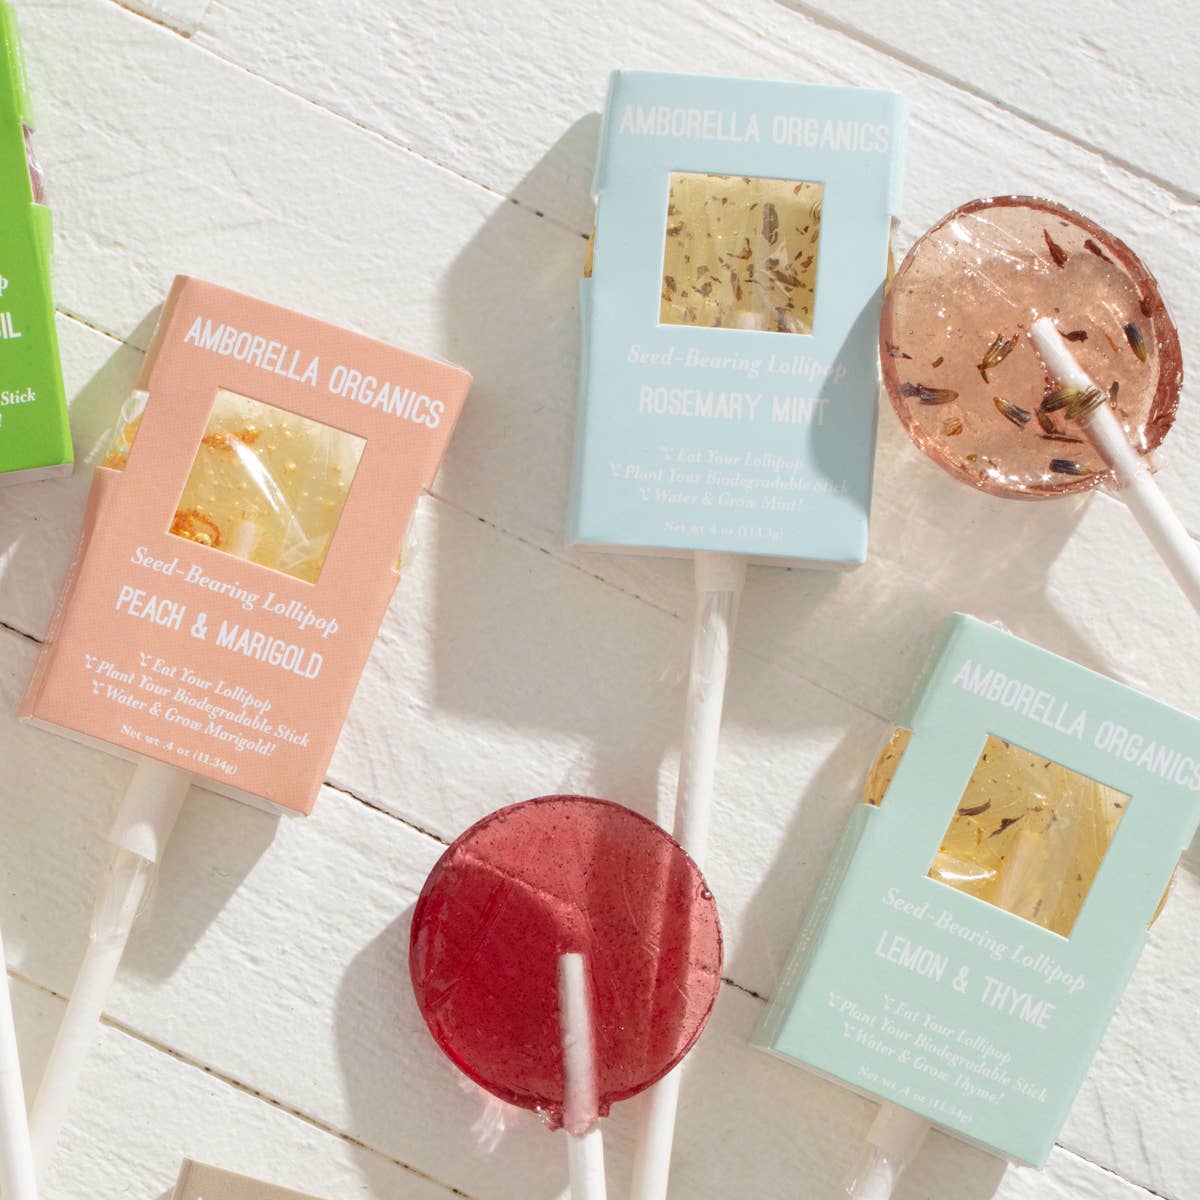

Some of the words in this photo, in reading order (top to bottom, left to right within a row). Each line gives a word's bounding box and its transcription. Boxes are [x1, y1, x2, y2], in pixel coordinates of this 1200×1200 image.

[618, 103, 761, 144] AMBORELLA
[772, 114, 889, 153] ORGANICS
[183, 316, 320, 388] AMBORELLA
[327, 364, 445, 429] ORGANICS
[627, 344, 763, 379] Seed-Bearing
[767, 352, 848, 385] Lollipop
[639, 384, 764, 421] ROSEMARY
[771, 393, 831, 426] MINT
[114, 585, 187, 631] PEACH
[190, 611, 208, 641] &
[215, 619, 324, 680] MARIGOLD
[129, 545, 261, 612] Seed-Bearing
[261, 591, 340, 639] Lollipop
[106, 684, 148, 710] Water
[148, 701, 162, 718] &
[164, 707, 203, 732] Grow
[203, 720, 277, 757] Marigold!
[951, 658, 1088, 740] AMBORELLA
[874, 928, 949, 982] LEMON
[951, 965, 970, 994] &
[981, 975, 1057, 1030] THYME
[882, 887, 1009, 961] Seed-Bearing
[1009, 943, 1086, 995] Lollipop
